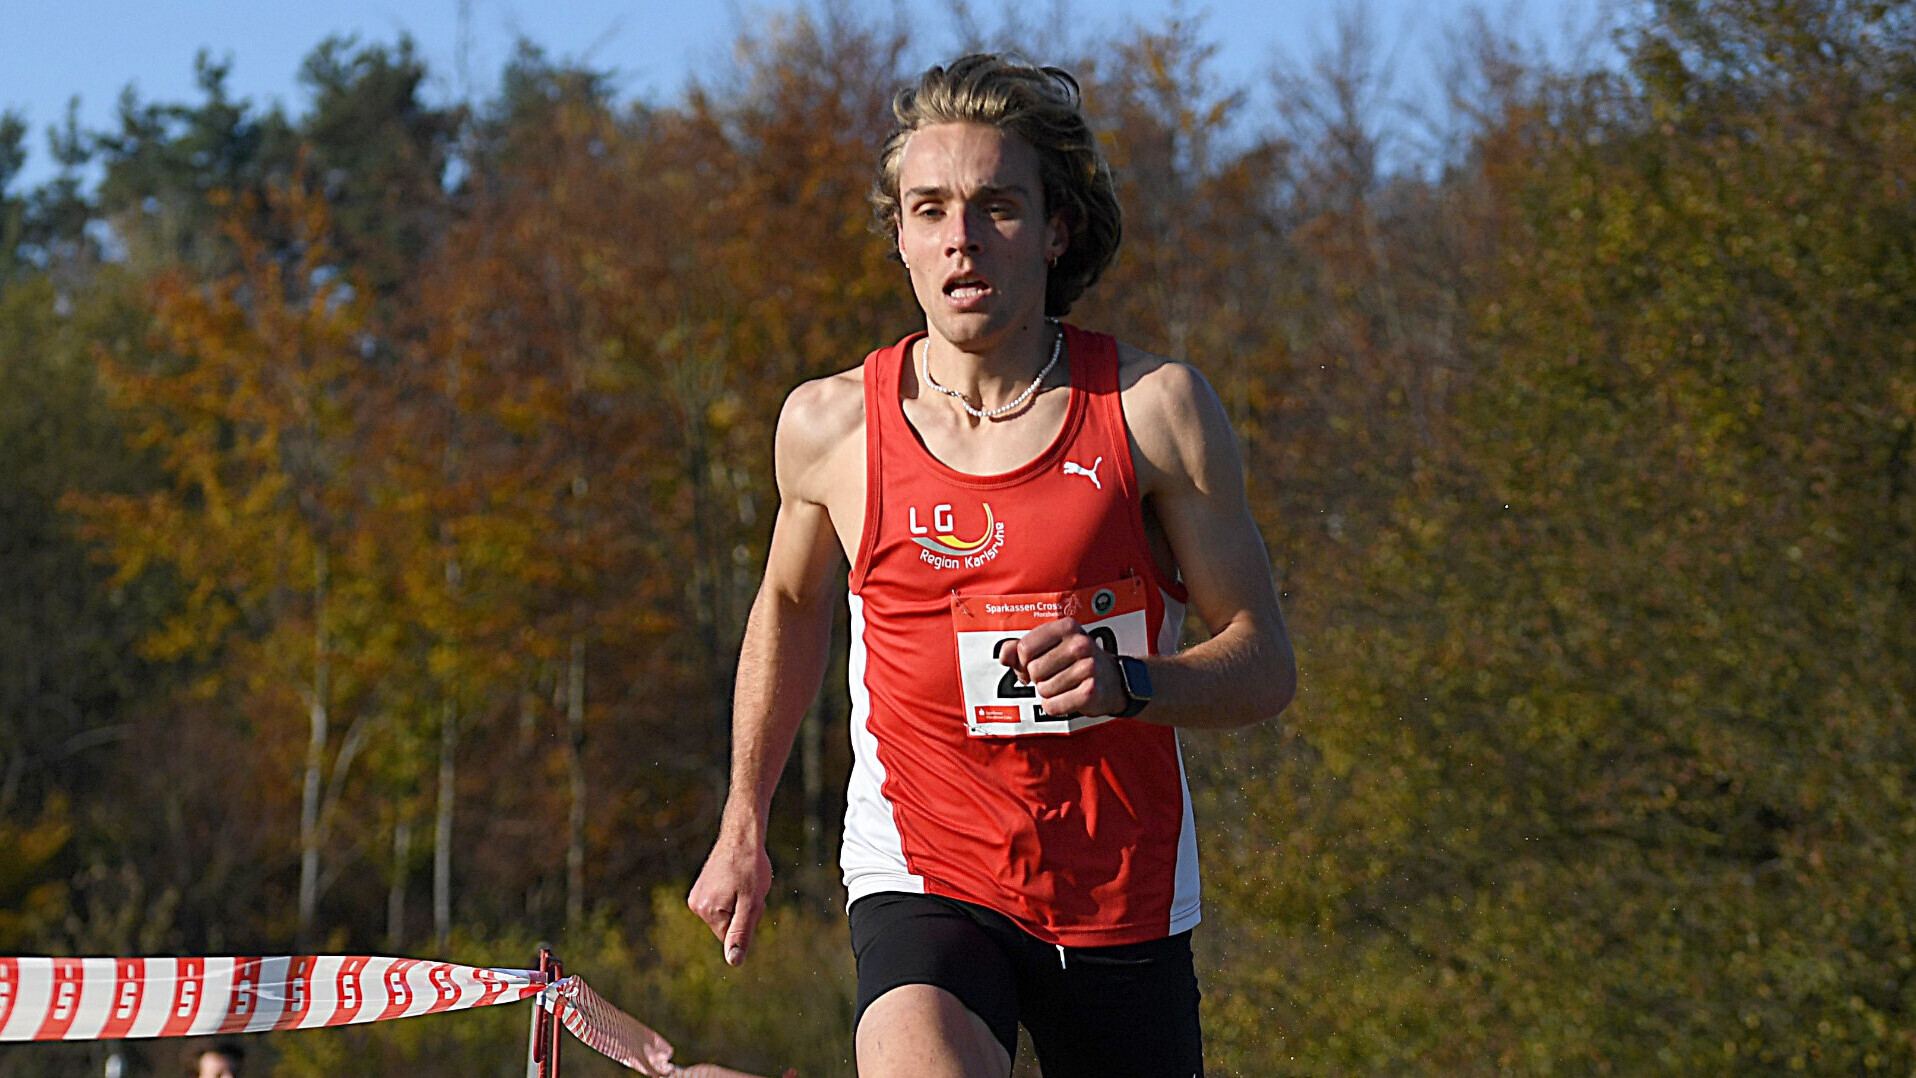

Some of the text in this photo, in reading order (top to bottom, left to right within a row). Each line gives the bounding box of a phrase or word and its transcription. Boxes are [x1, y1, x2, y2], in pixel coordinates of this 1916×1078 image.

[920, 522, 1005, 570] Region Karlsruhe
[985, 602, 1062, 614] Sparkassen Cross
